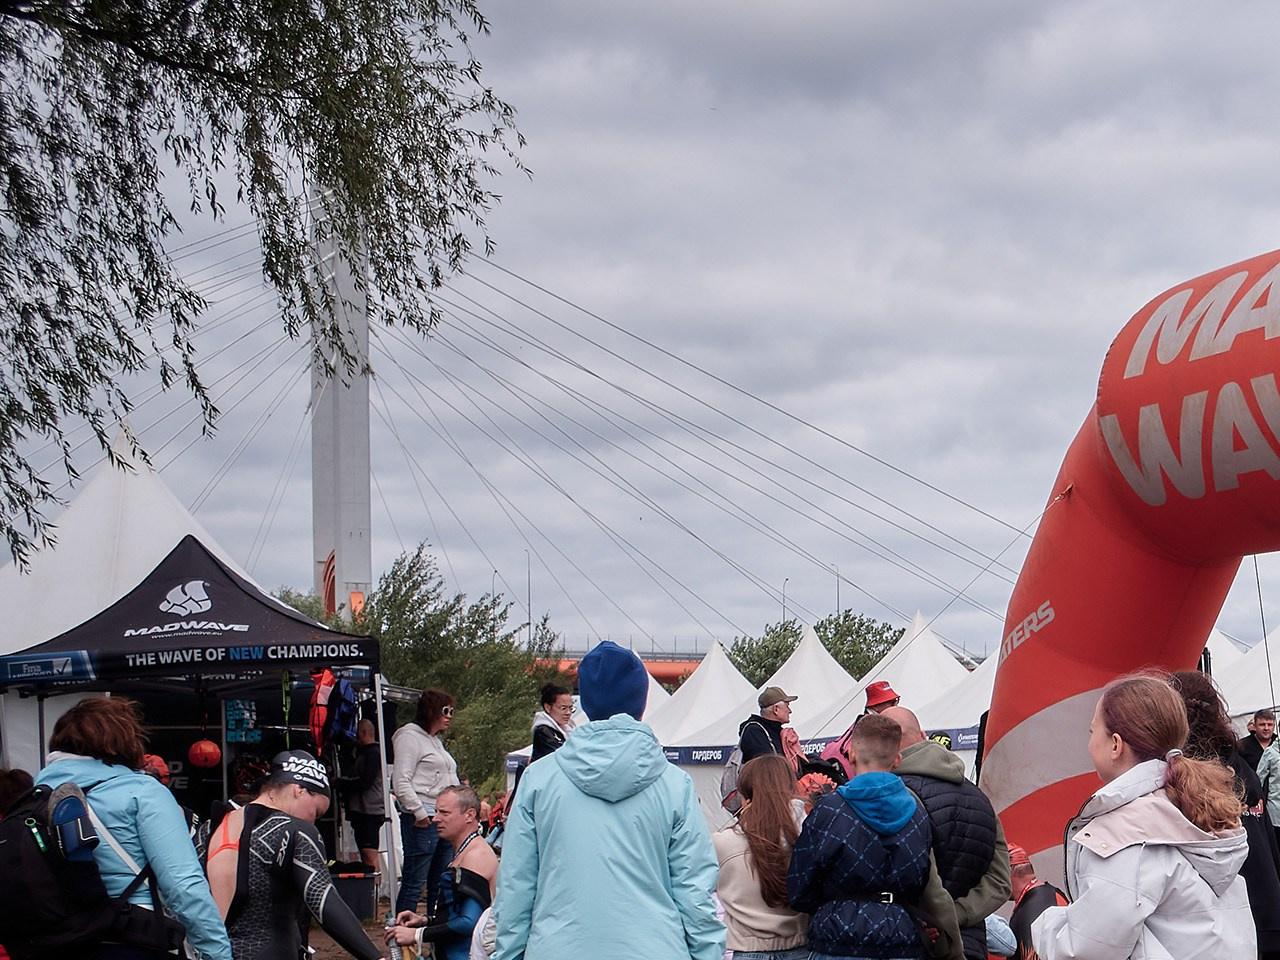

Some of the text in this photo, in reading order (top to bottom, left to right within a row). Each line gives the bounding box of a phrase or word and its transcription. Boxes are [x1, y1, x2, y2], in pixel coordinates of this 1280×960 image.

[124, 620, 250, 637] MADWAVE
[126, 644, 363, 667] THE WAVE OF NEW CHAMPIONS.
[692, 750, 723, 761] ГАРДЕРОБ
[289, 756, 326, 774] MAD
